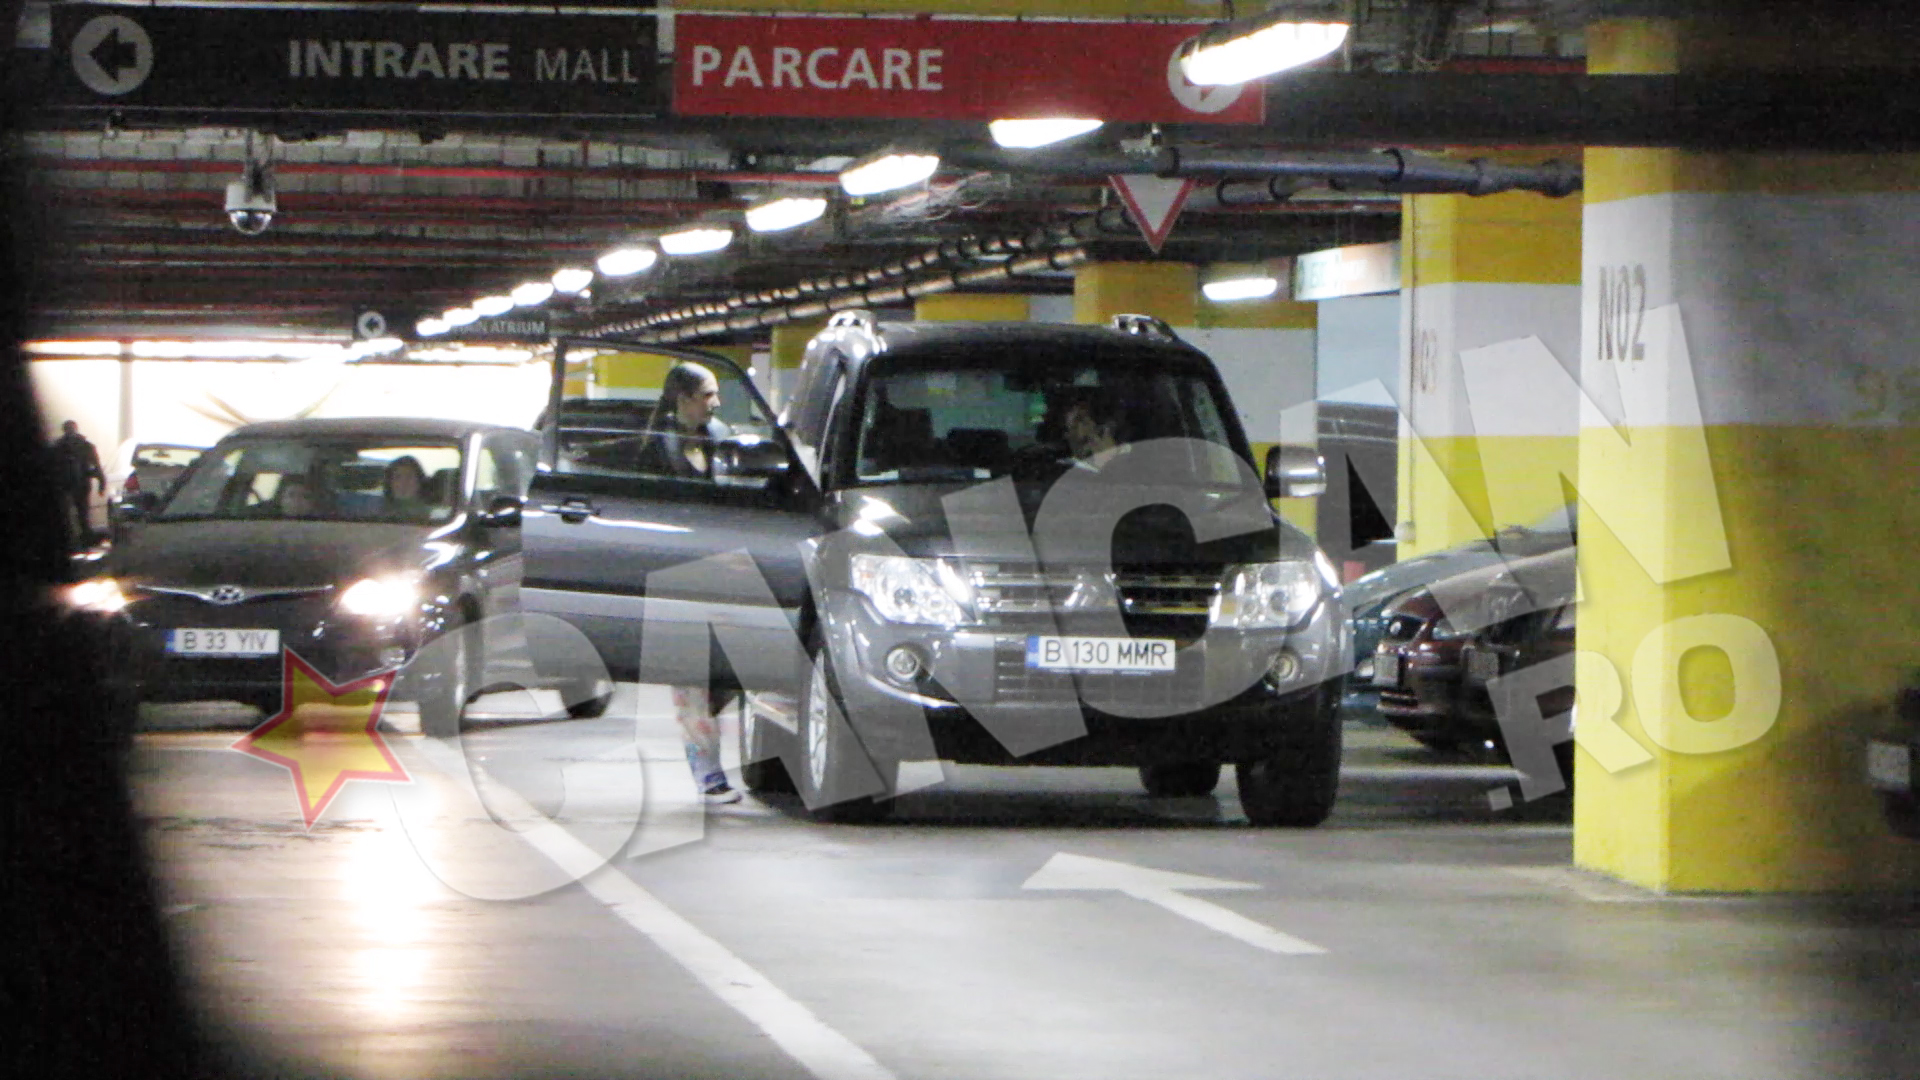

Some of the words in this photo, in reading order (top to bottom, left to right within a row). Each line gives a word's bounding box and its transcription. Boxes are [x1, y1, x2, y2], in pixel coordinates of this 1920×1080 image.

[288, 39, 510, 80] INTRARE
[535, 47, 639, 83] MALL
[692, 45, 944, 91] PARCARE
[491, 320, 545, 335] ATRIUM
[184, 632, 197, 649] B
[205, 632, 226, 649] 33
[1045, 640, 1061, 662] B
[1073, 641, 1109, 664] 130
[1118, 642, 1166, 666] MMR
